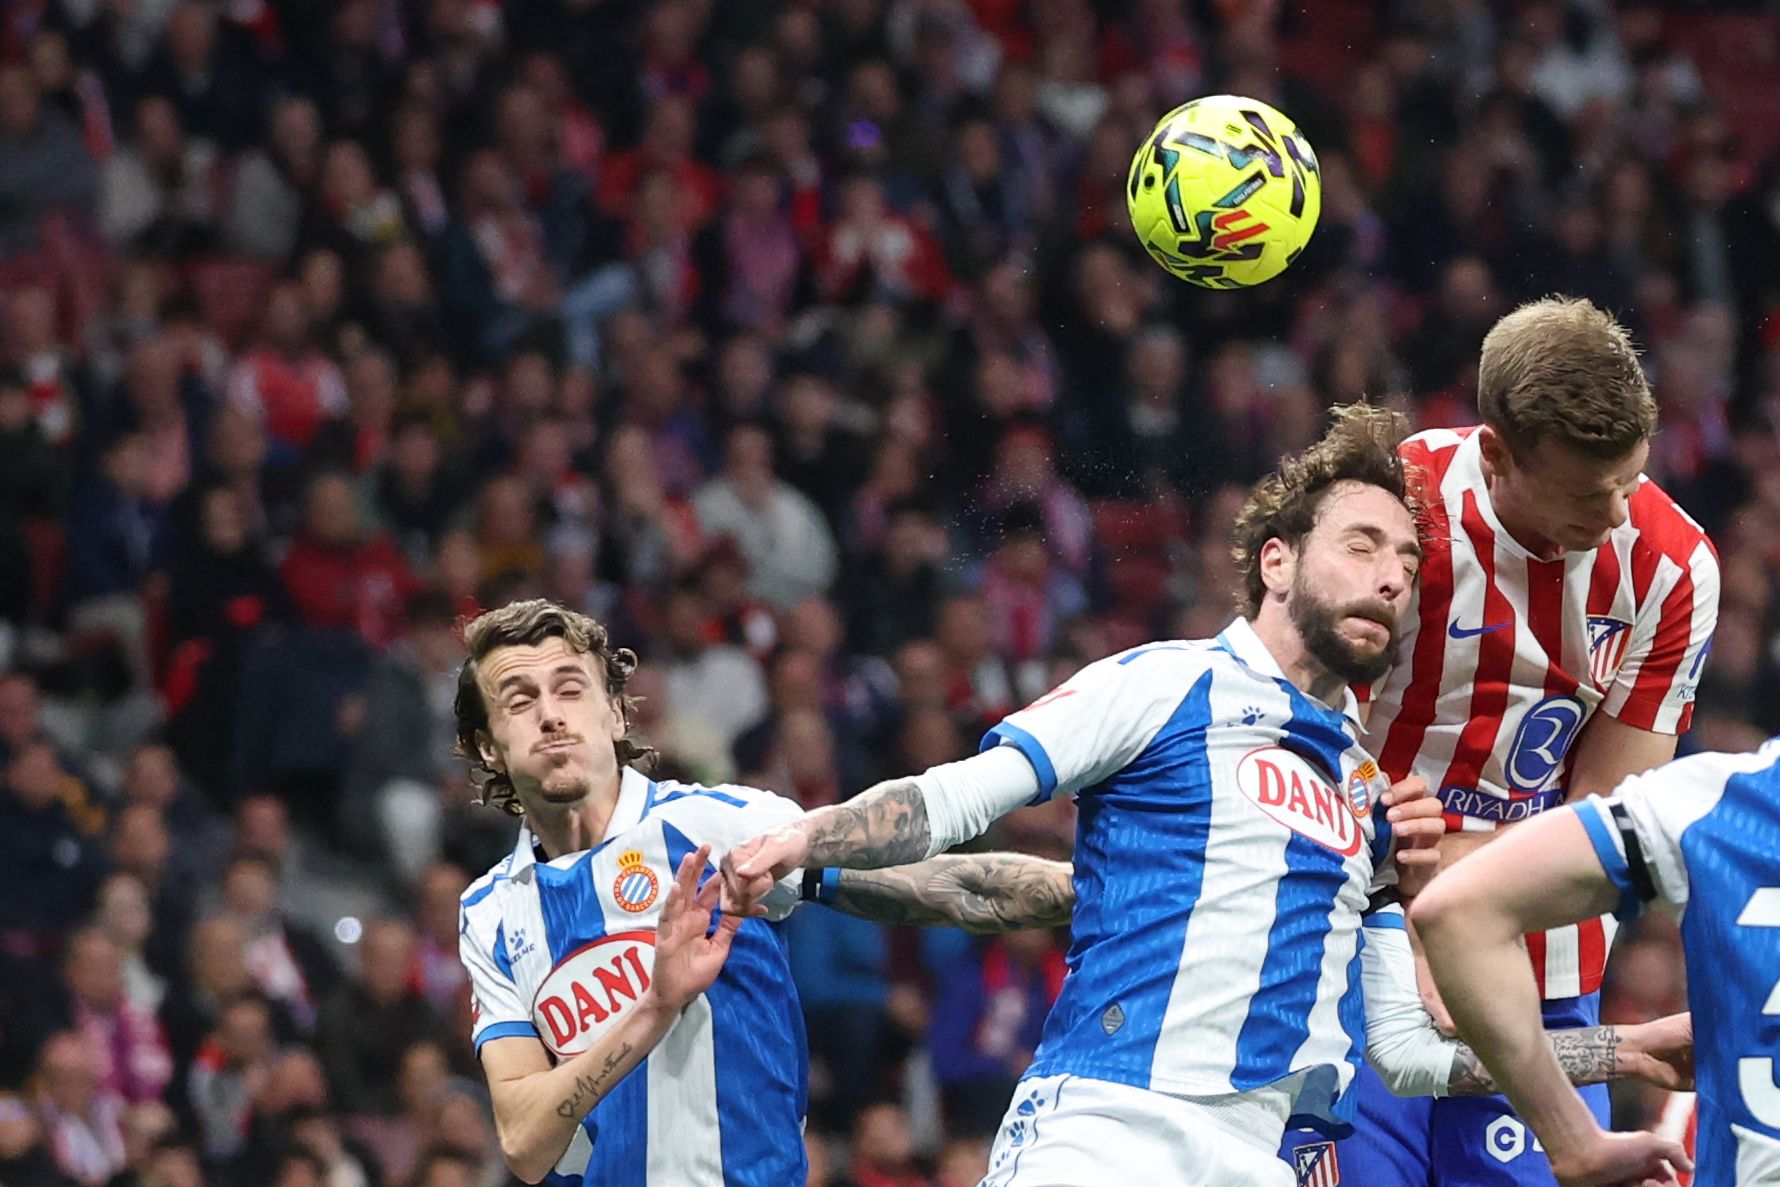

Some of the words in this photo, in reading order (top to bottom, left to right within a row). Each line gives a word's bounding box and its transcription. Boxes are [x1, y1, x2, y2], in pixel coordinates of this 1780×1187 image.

[1254, 758, 1347, 842] DANI
[1444, 788, 1545, 820] RIYADH
[538, 946, 651, 1048] DANI
